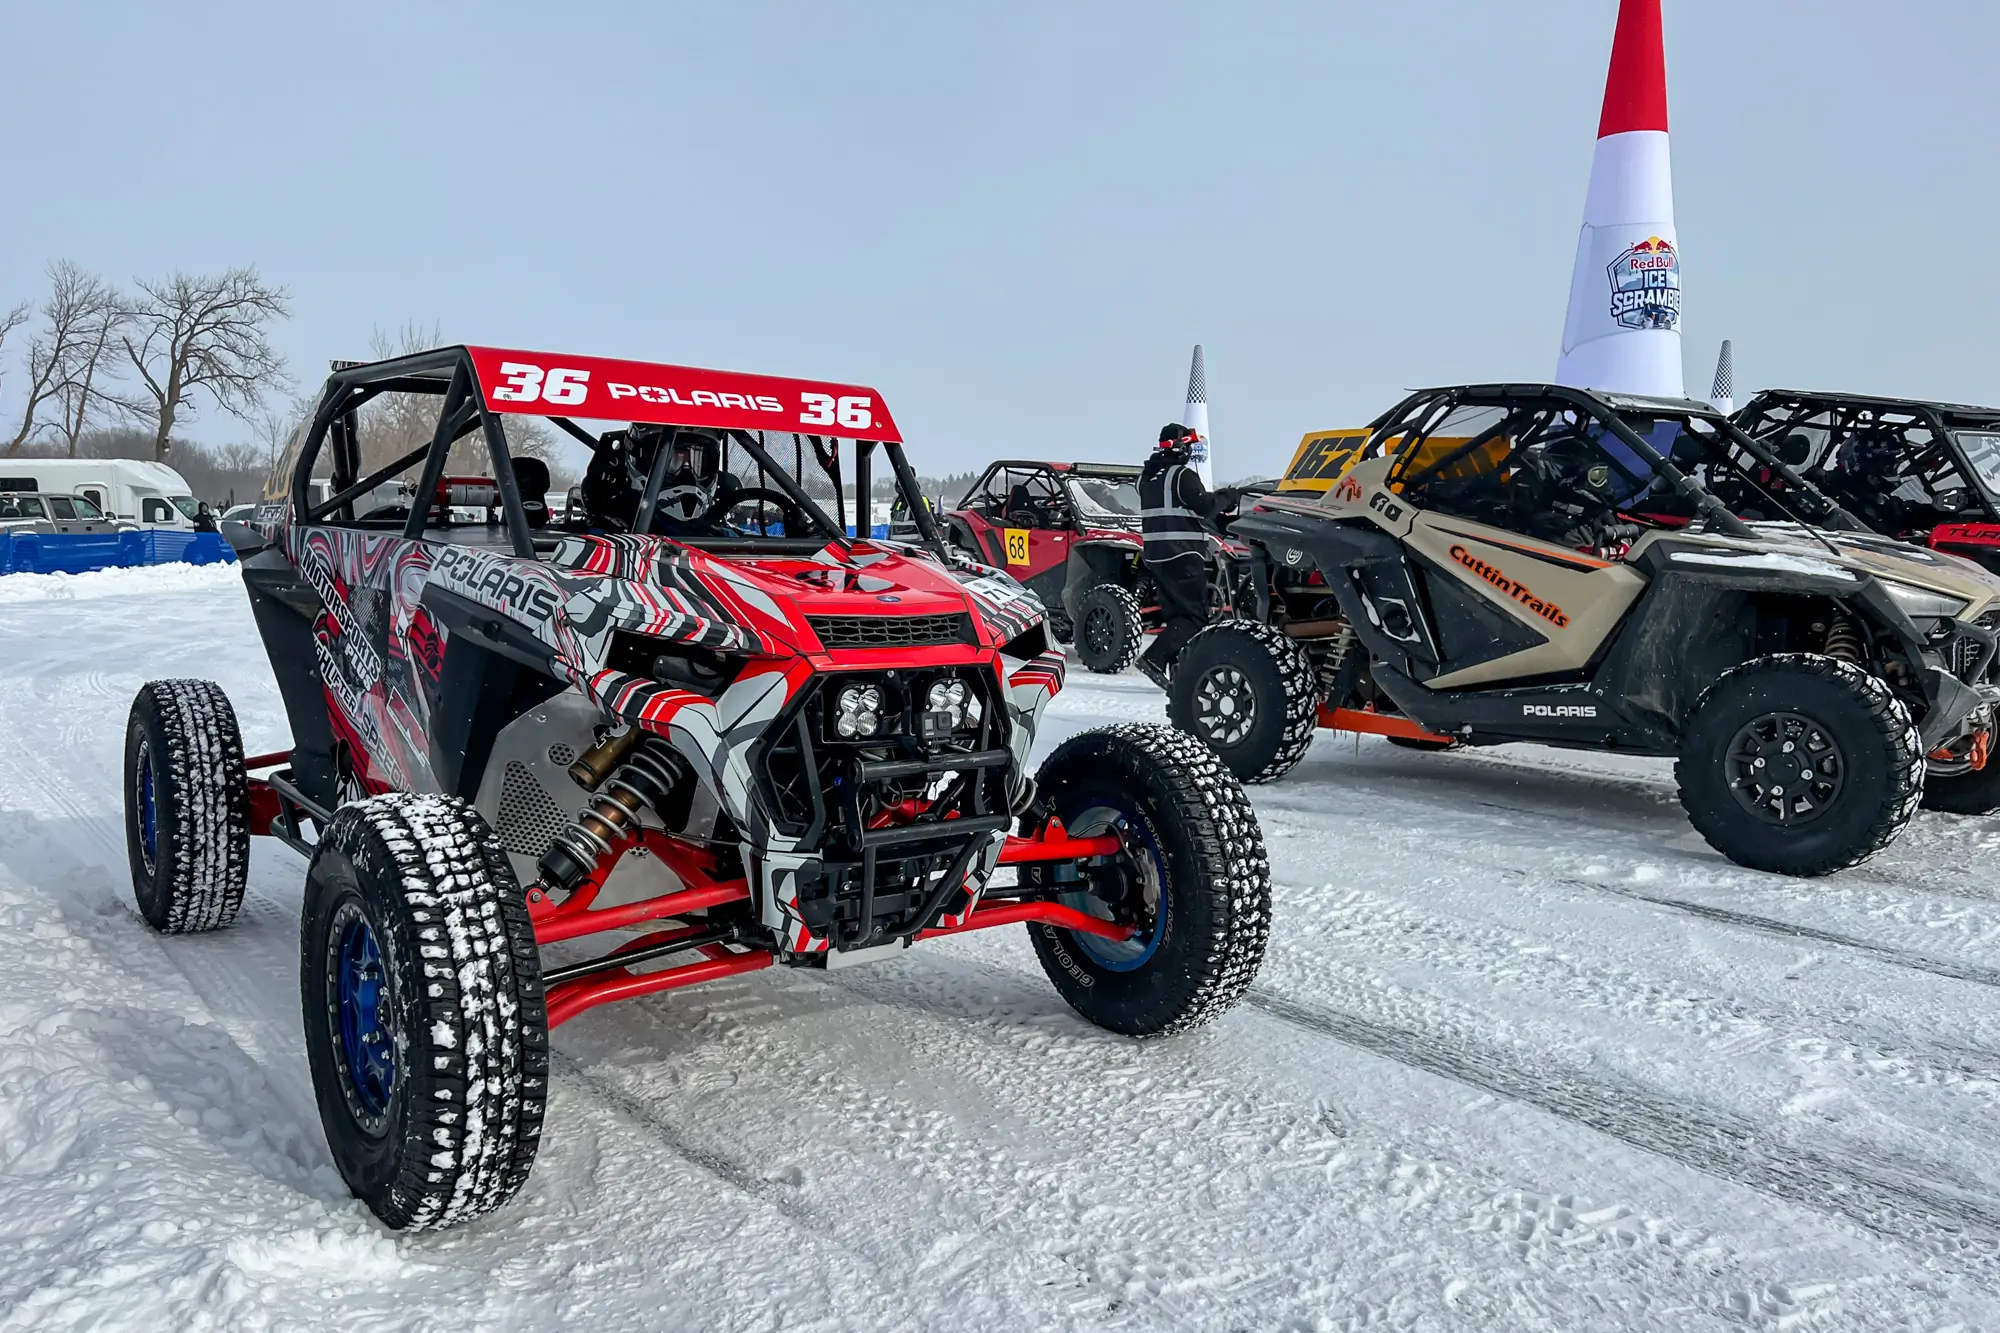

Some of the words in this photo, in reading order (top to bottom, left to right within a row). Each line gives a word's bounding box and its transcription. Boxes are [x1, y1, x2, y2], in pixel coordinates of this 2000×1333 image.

[1630, 257, 1655, 270] Red
[1656, 256, 1674, 268] Bull
[1643, 269, 1667, 288] ICE
[492, 361, 591, 405] 36
[606, 382, 784, 413] POLARIS
[800, 392, 872, 430] 36
[1285, 435, 1366, 480] 162
[1009, 536, 1026, 560] 68
[434, 547, 560, 622] POLARIS
[1449, 545, 1571, 629] CuttinTrails
[301, 543, 382, 683] MOTORSPORTS
[345, 643, 373, 692] PLUS
[1523, 704, 1597, 718] POLARIS
